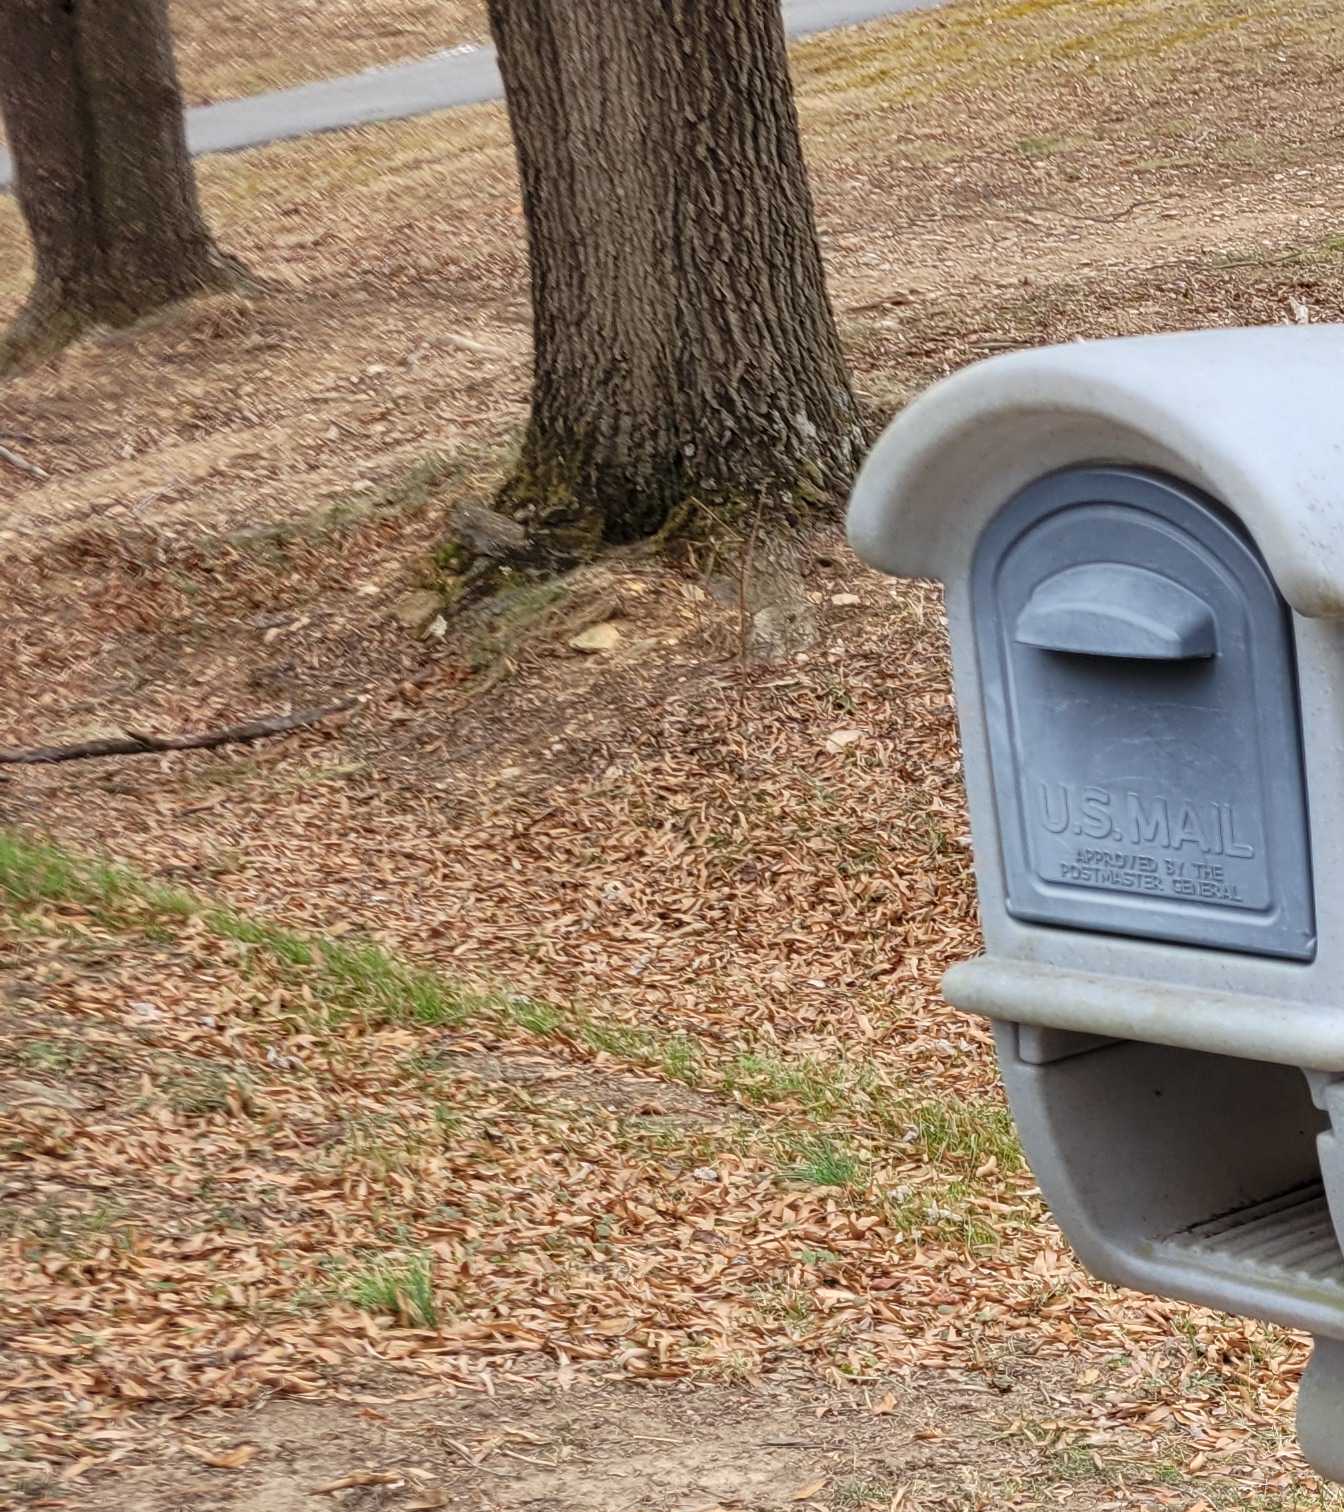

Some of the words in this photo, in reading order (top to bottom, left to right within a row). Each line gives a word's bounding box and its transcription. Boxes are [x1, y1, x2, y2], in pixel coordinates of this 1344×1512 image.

[1040, 783, 1123, 842] U.S.
[1127, 791, 1255, 859] MAIL
[1059, 863, 1165, 891] POSTMASTER
[1172, 878, 1243, 902] GENERAL
[1075, 848, 1159, 874] APPROVED
[1164, 858, 1186, 877] BY
[1191, 862, 1225, 883] THE
